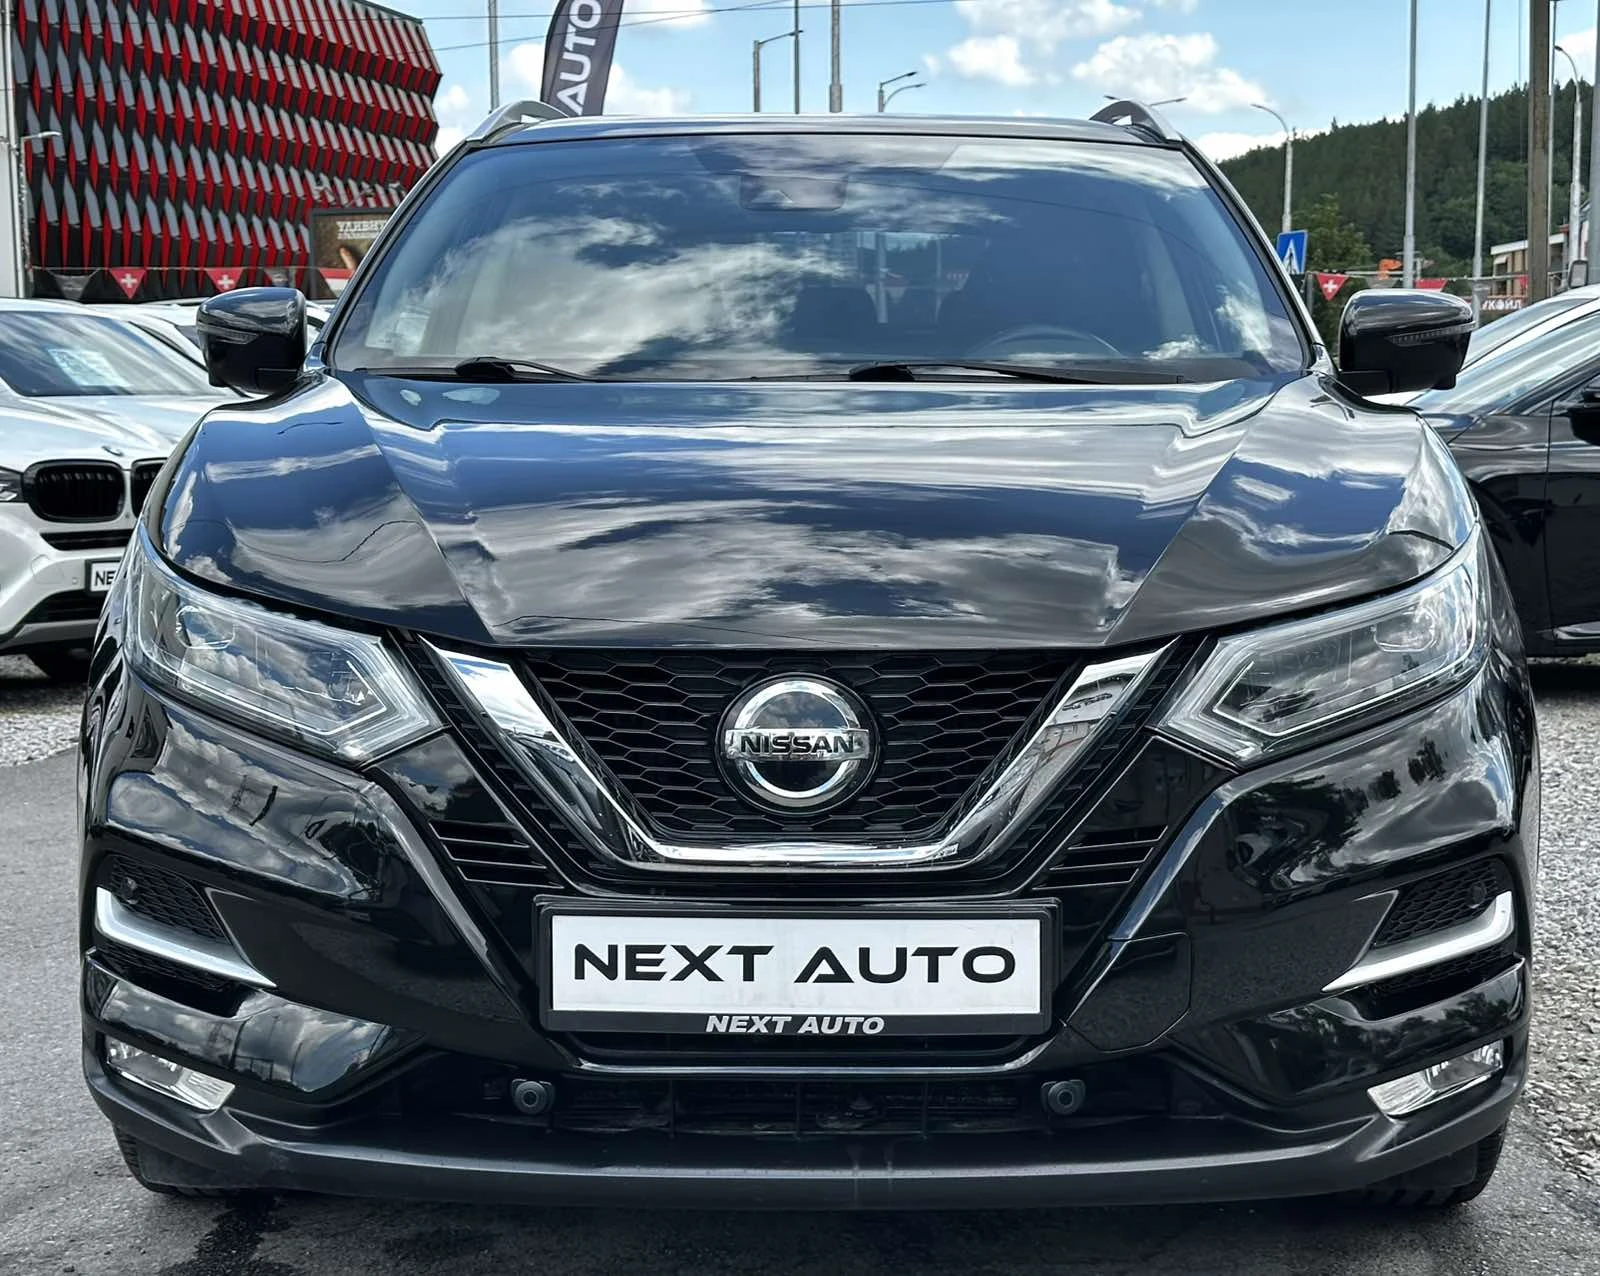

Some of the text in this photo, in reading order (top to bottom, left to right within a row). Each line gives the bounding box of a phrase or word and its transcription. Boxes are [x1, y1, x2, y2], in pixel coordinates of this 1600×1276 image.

[556, 0, 602, 116] AUTO
[740, 735, 855, 753] NISSAN
[574, 943, 1016, 984] NEXT AUTO
[706, 1015, 885, 1035] NEXT AUTO
